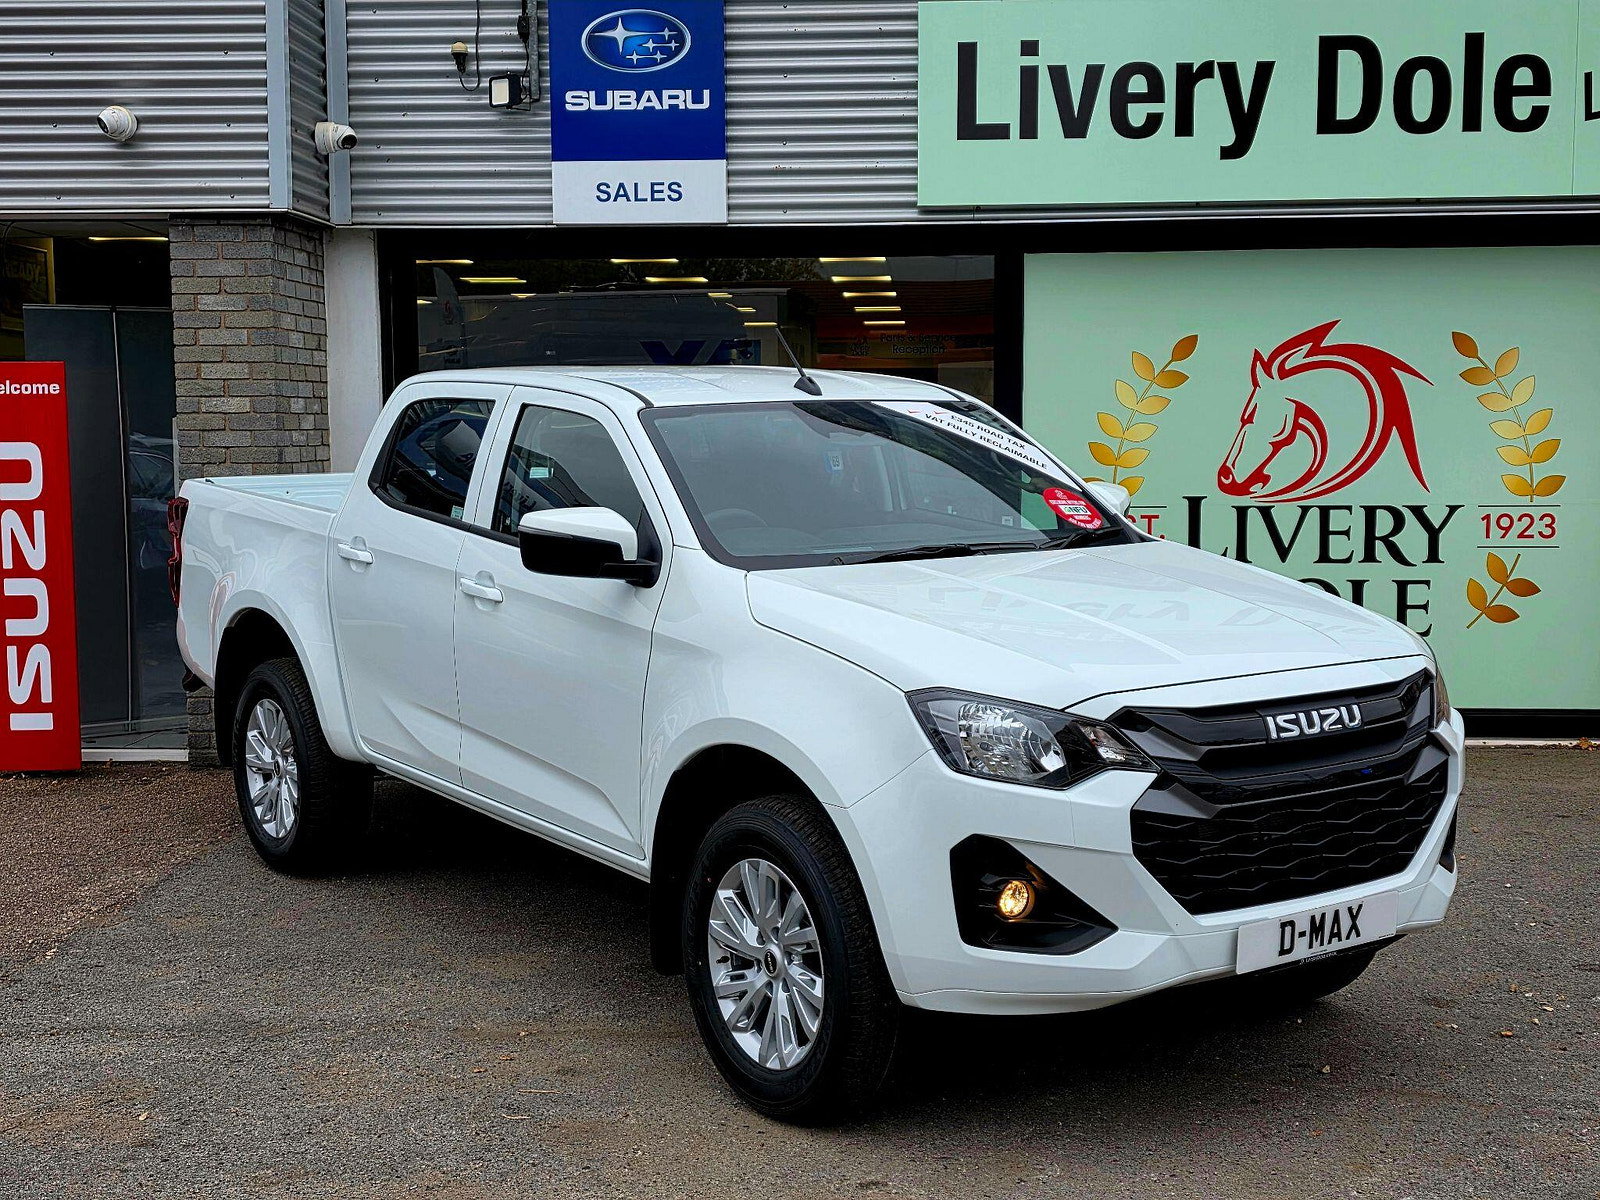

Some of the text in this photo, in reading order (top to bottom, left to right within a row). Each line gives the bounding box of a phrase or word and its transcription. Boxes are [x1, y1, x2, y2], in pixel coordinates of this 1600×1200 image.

[565, 88, 710, 111] SUBARU
[957, 40, 1276, 160] Livery
[1317, 32, 1551, 134] Dole
[595, 181, 683, 203] SALES
[892, 344, 946, 355] Reception
[925, 413, 1047, 469] VAT FULLY RECLAIMABLE
[977, 425, 1004, 440] ROAD
[1007, 437, 1025, 450] TAX
[1126, 513, 1166, 540] T.
[1183, 496, 1465, 567] LIVERY
[1480, 512, 1558, 540] 1923
[0, 441, 54, 731] ISUZU
[1266, 704, 1361, 739] ISUZU
[1278, 903, 1363, 957] D-MAX
